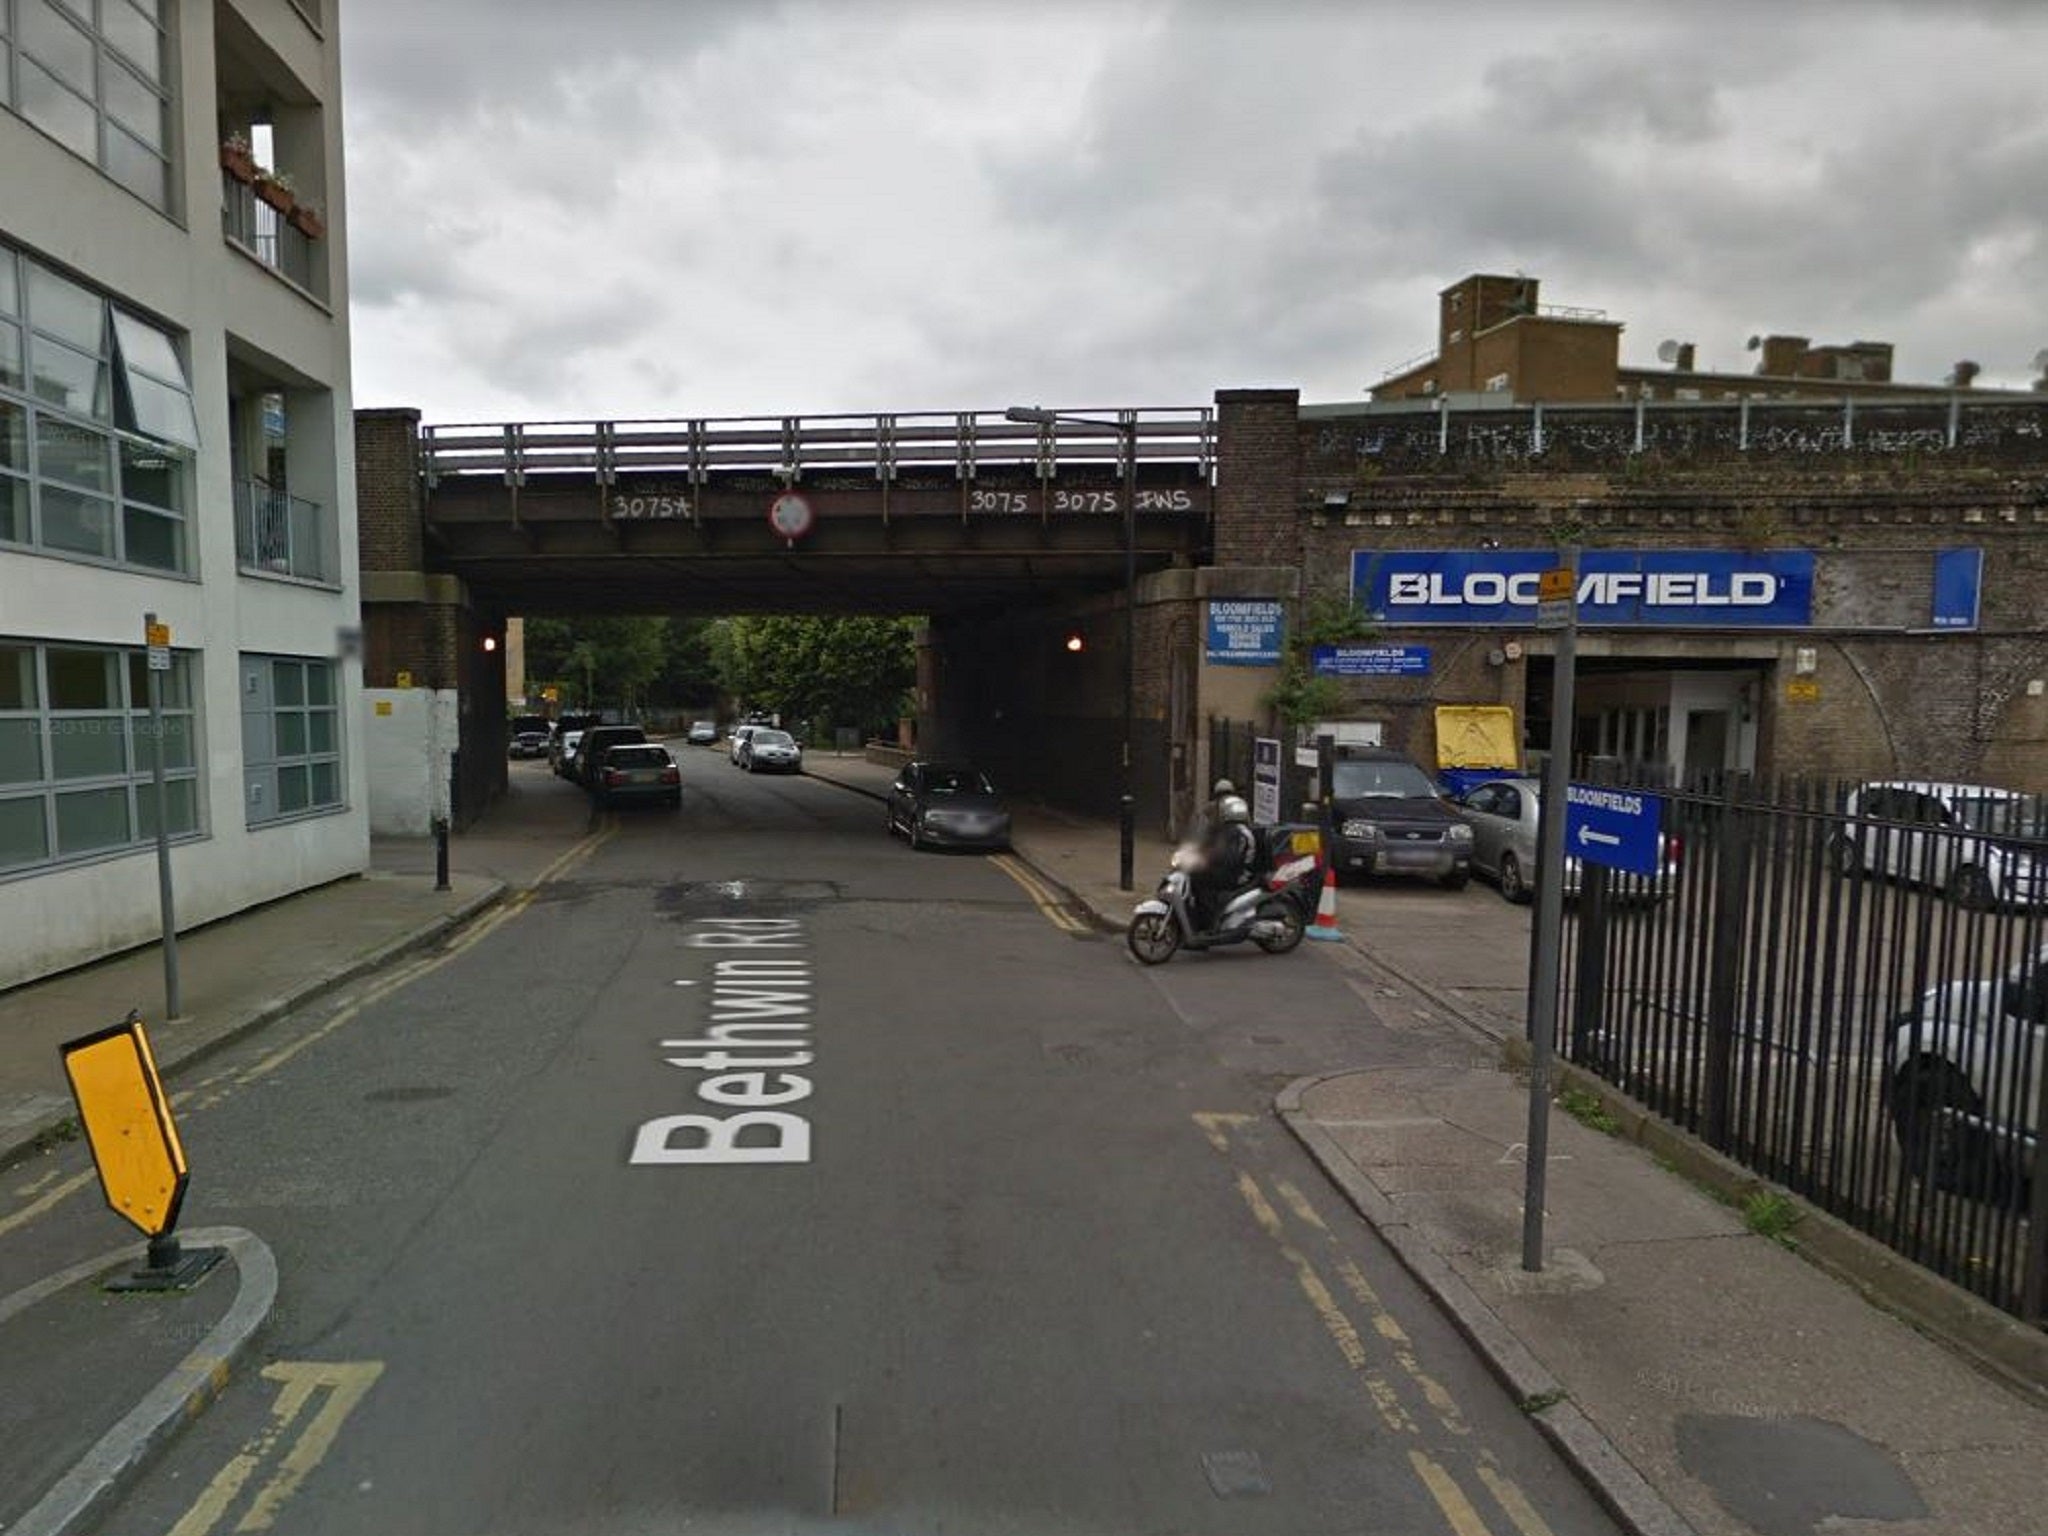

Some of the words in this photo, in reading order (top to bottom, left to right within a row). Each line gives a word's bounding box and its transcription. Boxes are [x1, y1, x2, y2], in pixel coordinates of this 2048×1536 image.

[971, 490, 1028, 512] 3075
[1055, 490, 1118, 512] 3075
[1210, 602, 1282, 615] BLOOMFIELDS
[1336, 649, 1405, 657] BLOOMFIELDS
[1567, 786, 1643, 815] BLOOMFIELDS
